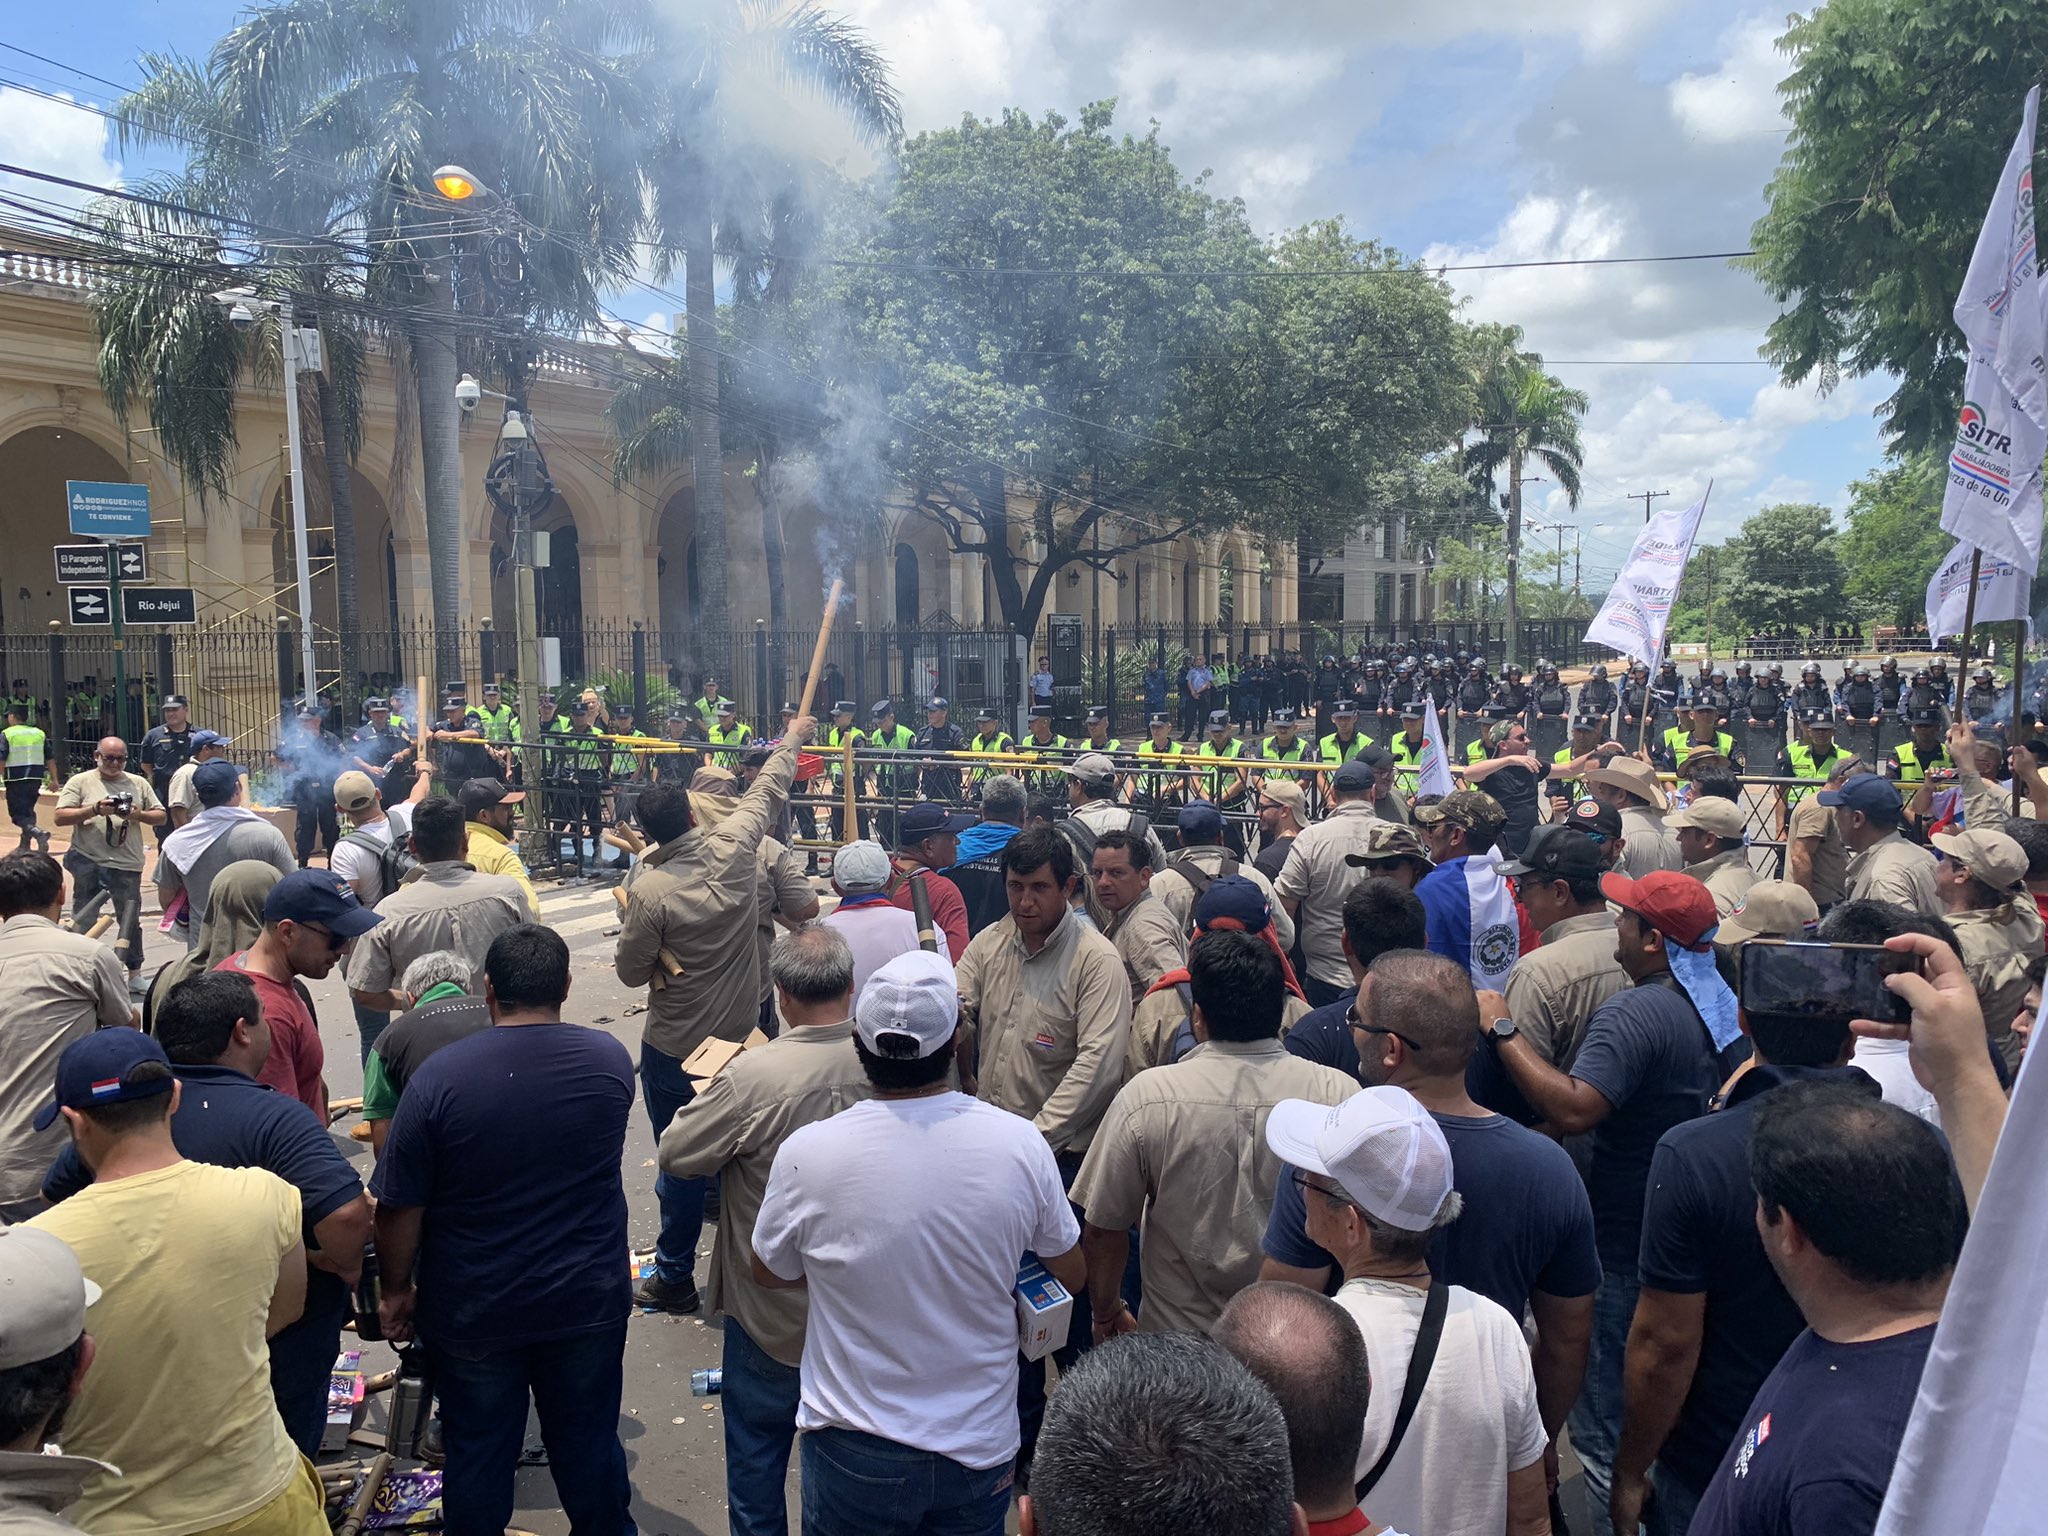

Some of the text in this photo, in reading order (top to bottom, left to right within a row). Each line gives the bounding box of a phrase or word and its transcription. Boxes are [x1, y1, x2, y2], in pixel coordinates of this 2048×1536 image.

[1957, 447, 2011, 478] TRABAJADORES
[1966, 479, 1979, 493] de
[1980, 485, 1991, 498] la
[60, 554, 104, 566] El Paraguayo
[60, 565, 107, 576] Independiente
